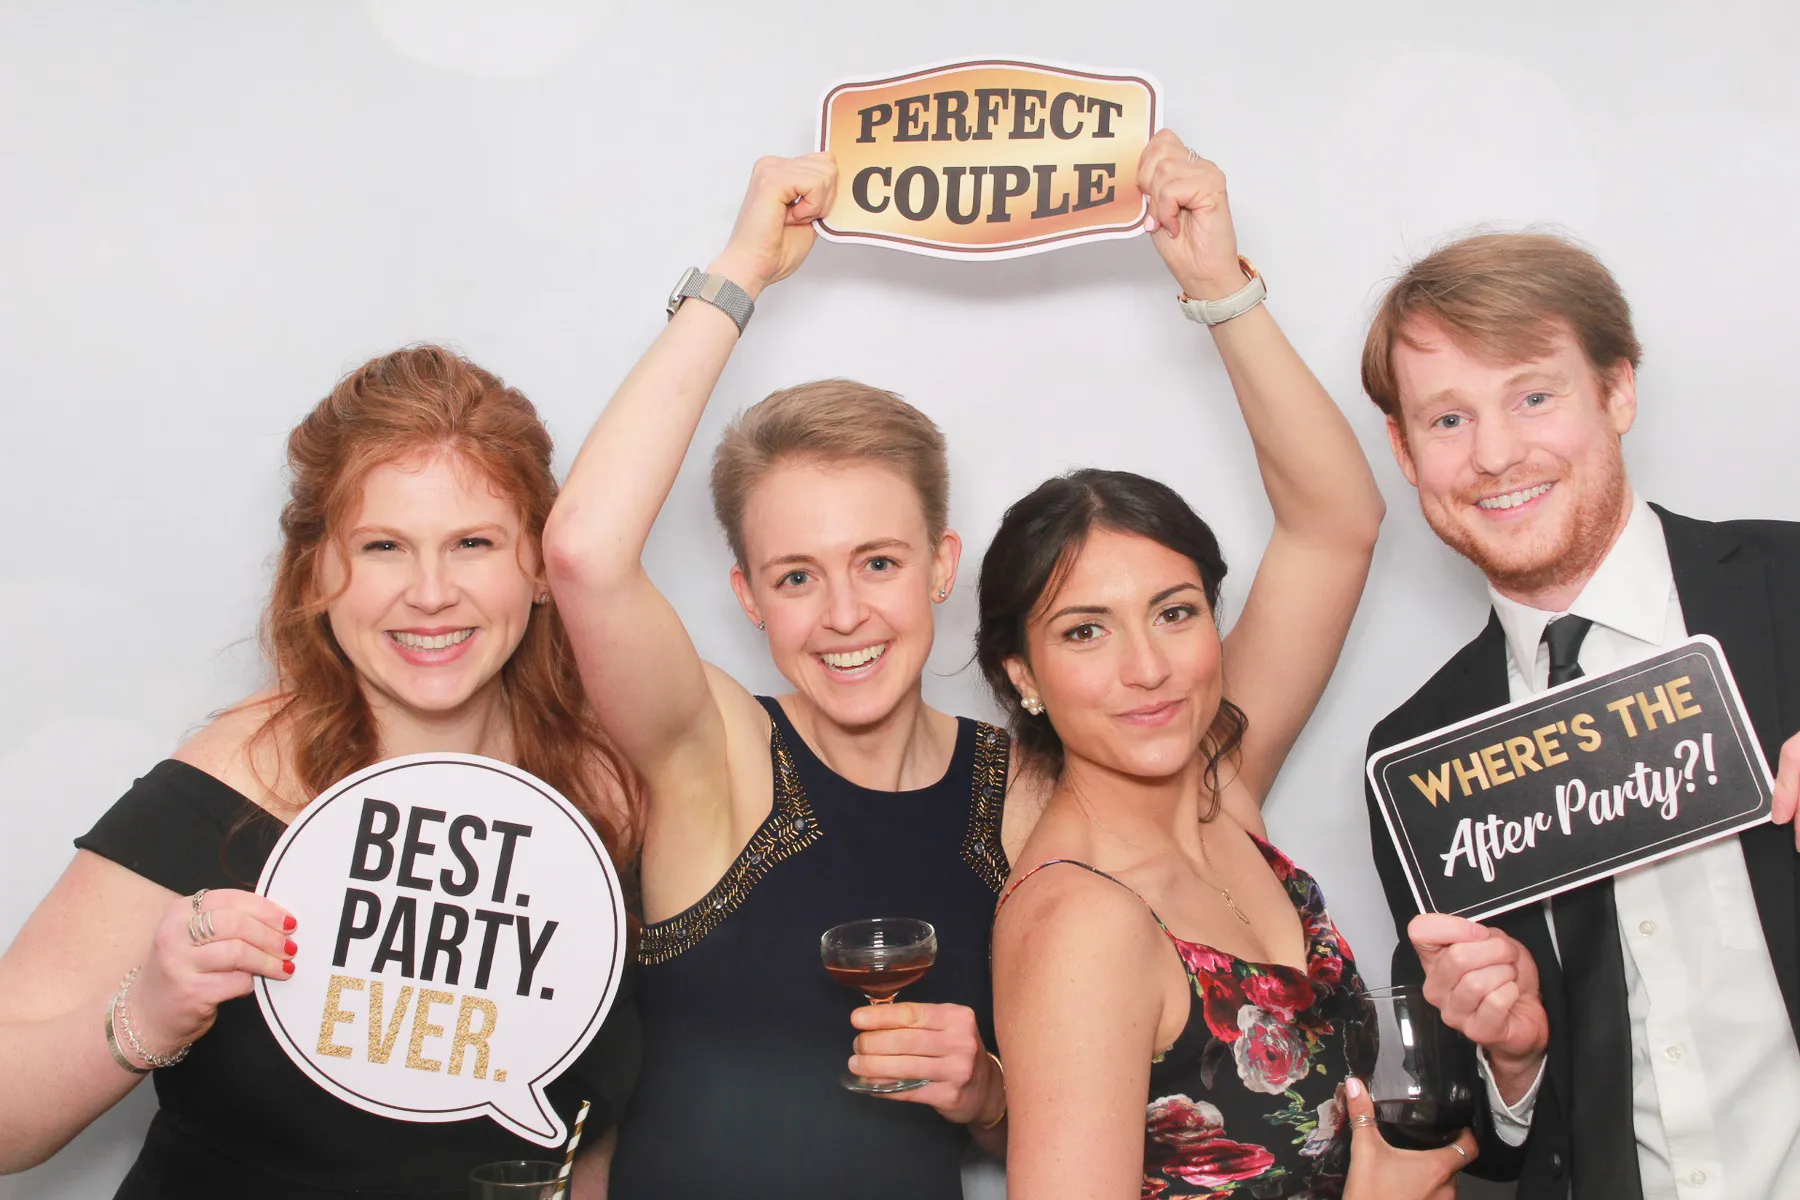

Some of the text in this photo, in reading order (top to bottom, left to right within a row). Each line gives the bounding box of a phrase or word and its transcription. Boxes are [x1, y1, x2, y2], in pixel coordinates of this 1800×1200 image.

[855, 88, 1123, 144] PERFECT
[852, 163, 1116, 225] COUPLE
[1408, 675, 1703, 808] WHERE'S THE
[348, 797, 533, 907] BEST.
[1440, 732, 1718, 883] After Party?!
[331, 887, 559, 1000] PARTY.
[316, 974, 508, 1082] EVER.
